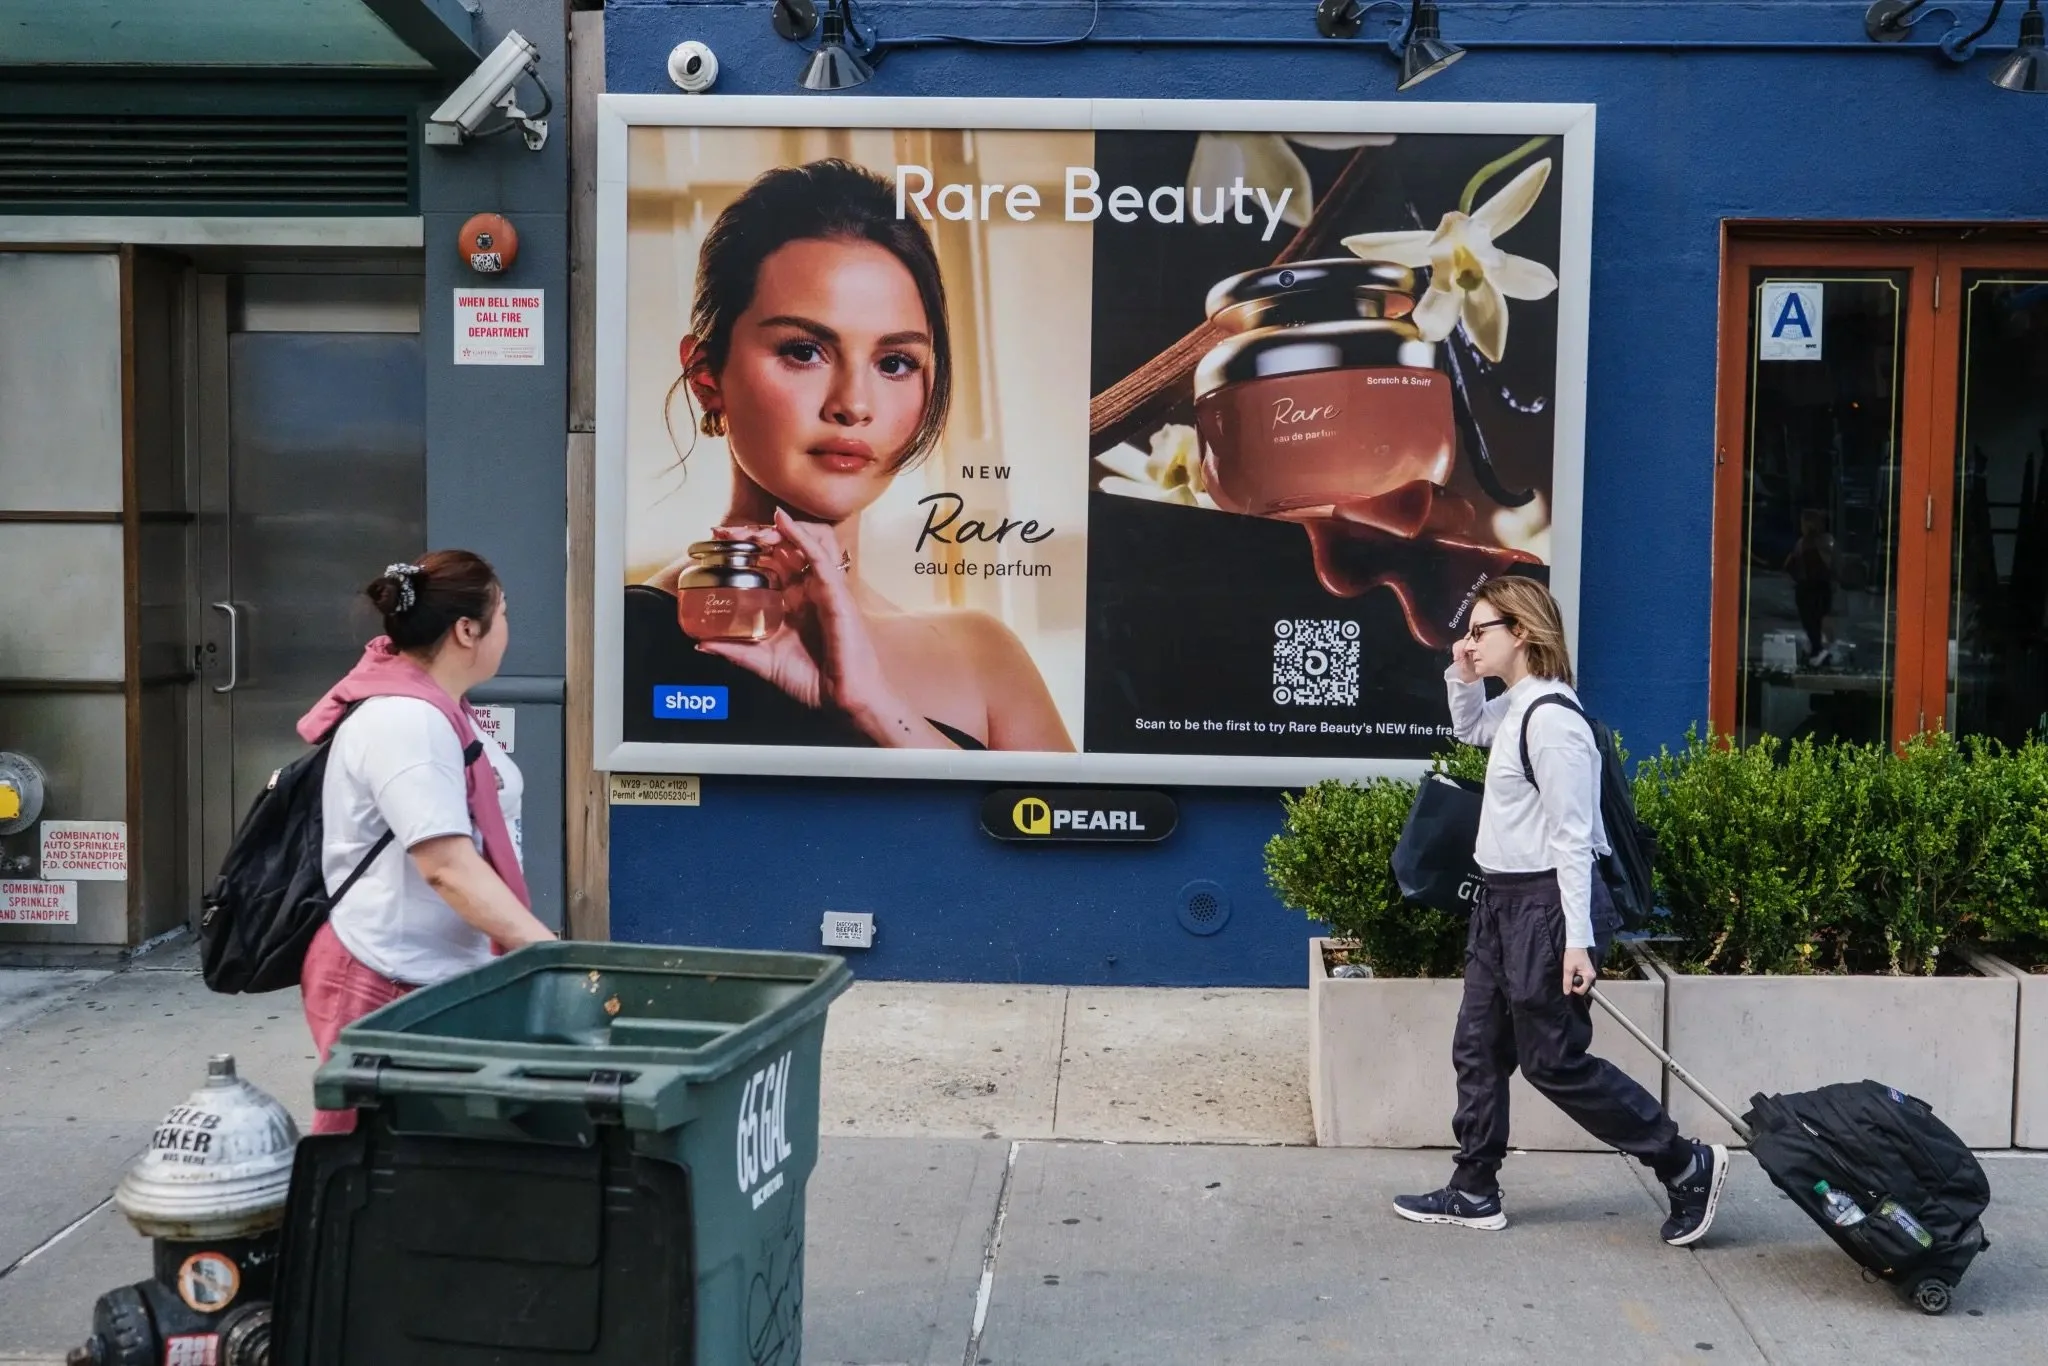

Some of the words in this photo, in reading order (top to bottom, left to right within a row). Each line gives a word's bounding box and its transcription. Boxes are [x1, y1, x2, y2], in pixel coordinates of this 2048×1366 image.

[895, 165, 1041, 222] Rare
[1065, 167, 1293, 241] Beauty
[458, 297, 485, 308] WHEN
[488, 297, 510, 308] BELL
[512, 297, 540, 308] RINGS
[476, 312, 497, 323] CALL
[501, 312, 522, 323] FIRE
[1771, 292, 1813, 338] A
[468, 327, 530, 338] DEPARTMENT
[1366, 376, 1400, 385] Scratch
[1402, 377, 1409, 385] &
[1410, 377, 1432, 387] Sniff
[1272, 397, 1341, 431] Rare
[1273, 435, 1290, 443] eau
[1291, 432, 1304, 441] de
[962, 465, 1011, 480] NEW
[915, 492, 1055, 553] Rare
[914, 562, 948, 575] eau
[954, 559, 978, 575] de
[984, 560, 1052, 580] parfum
[705, 593, 735, 606] Rare
[1448, 598, 1470, 629] Scratch
[665, 691, 717, 714] shop
[473, 709, 491, 718] PIPE
[1135, 718, 1166, 730] Scan
[1169, 720, 1182, 730] to
[1184, 719, 1200, 730] be
[1203, 719, 1223, 731] the
[1225, 720, 1251, 731] first
[1254, 722, 1266, 732] to
[1269, 722, 1286, 735] try
[1289, 721, 1317, 733] Rare
[1320, 722, 1373, 736] Beauty's
[1375, 723, 1407, 734] NEW
[1409, 723, 1433, 735] fine
[1436, 724, 1456, 738] fra
[620, 779, 641, 789] NY29
[649, 779, 666, 789] OAC
[612, 790, 636, 800] Permit
[1053, 809, 1146, 831] PEARL
[49, 831, 120, 841] COMBINATION
[43, 841, 71, 850] AUTO
[73, 841, 126, 851] SPRINKLER
[45, 851, 68, 860] AND
[70, 851, 124, 860] STANDPIPE
[42, 860, 60, 869] F.D.
[62, 860, 127, 870] CONNECTION
[2, 883, 65, 895] COMBINATION
[9, 897, 59, 908] SPRINKLER
[0, 909, 17, 920] AND
[20, 909, 70, 921] STANDPIPE
[836, 926, 862, 934] BEEPERS
